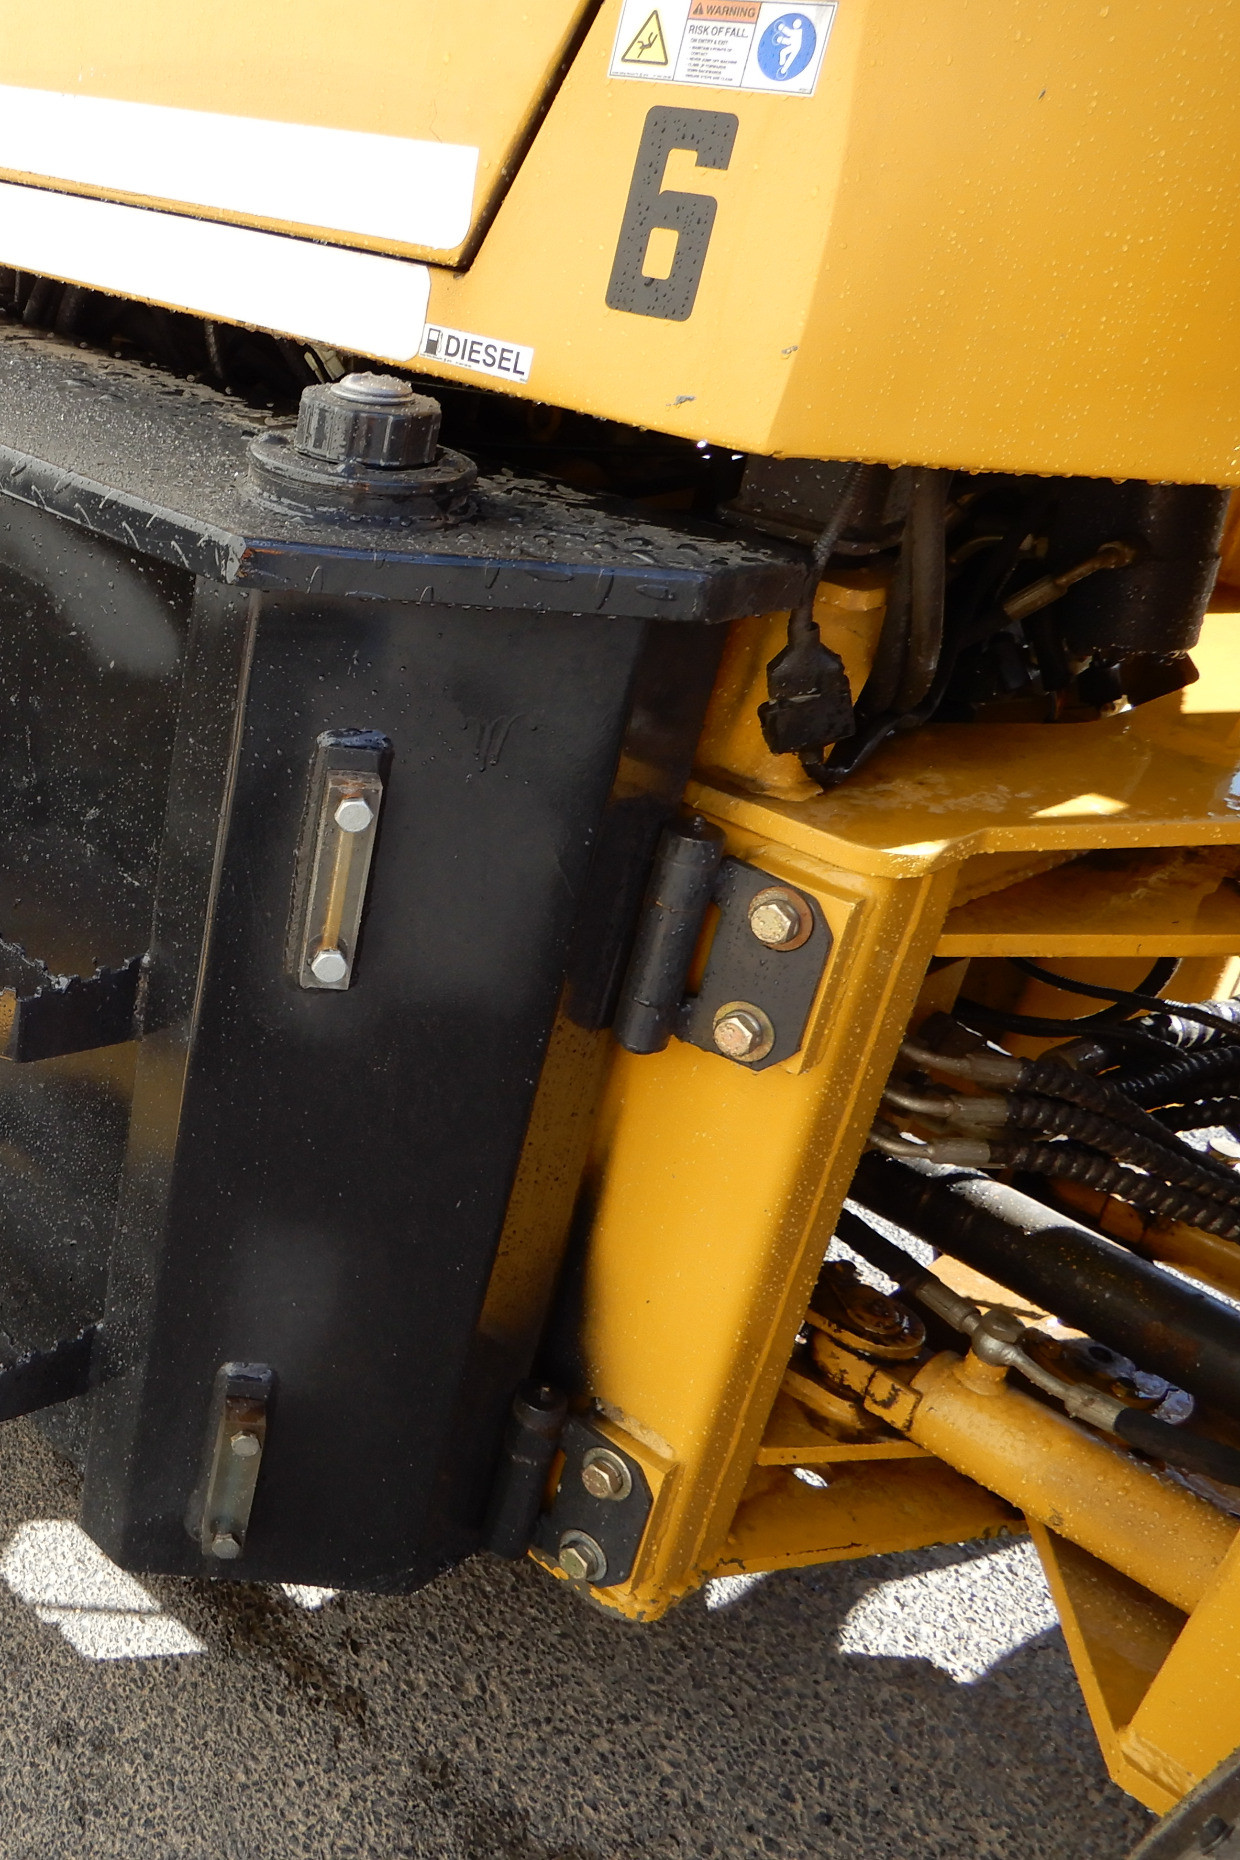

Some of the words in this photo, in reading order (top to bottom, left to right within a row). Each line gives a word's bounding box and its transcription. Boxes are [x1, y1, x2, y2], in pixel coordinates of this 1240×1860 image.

[706, 5, 756, 17] WARNING
[688, 24, 710, 36] RISK
[711, 26, 725, 36] OF
[725, 27, 749, 38] FALL
[604, 105, 740, 323] 6
[444, 334, 525, 375] DIESEL
